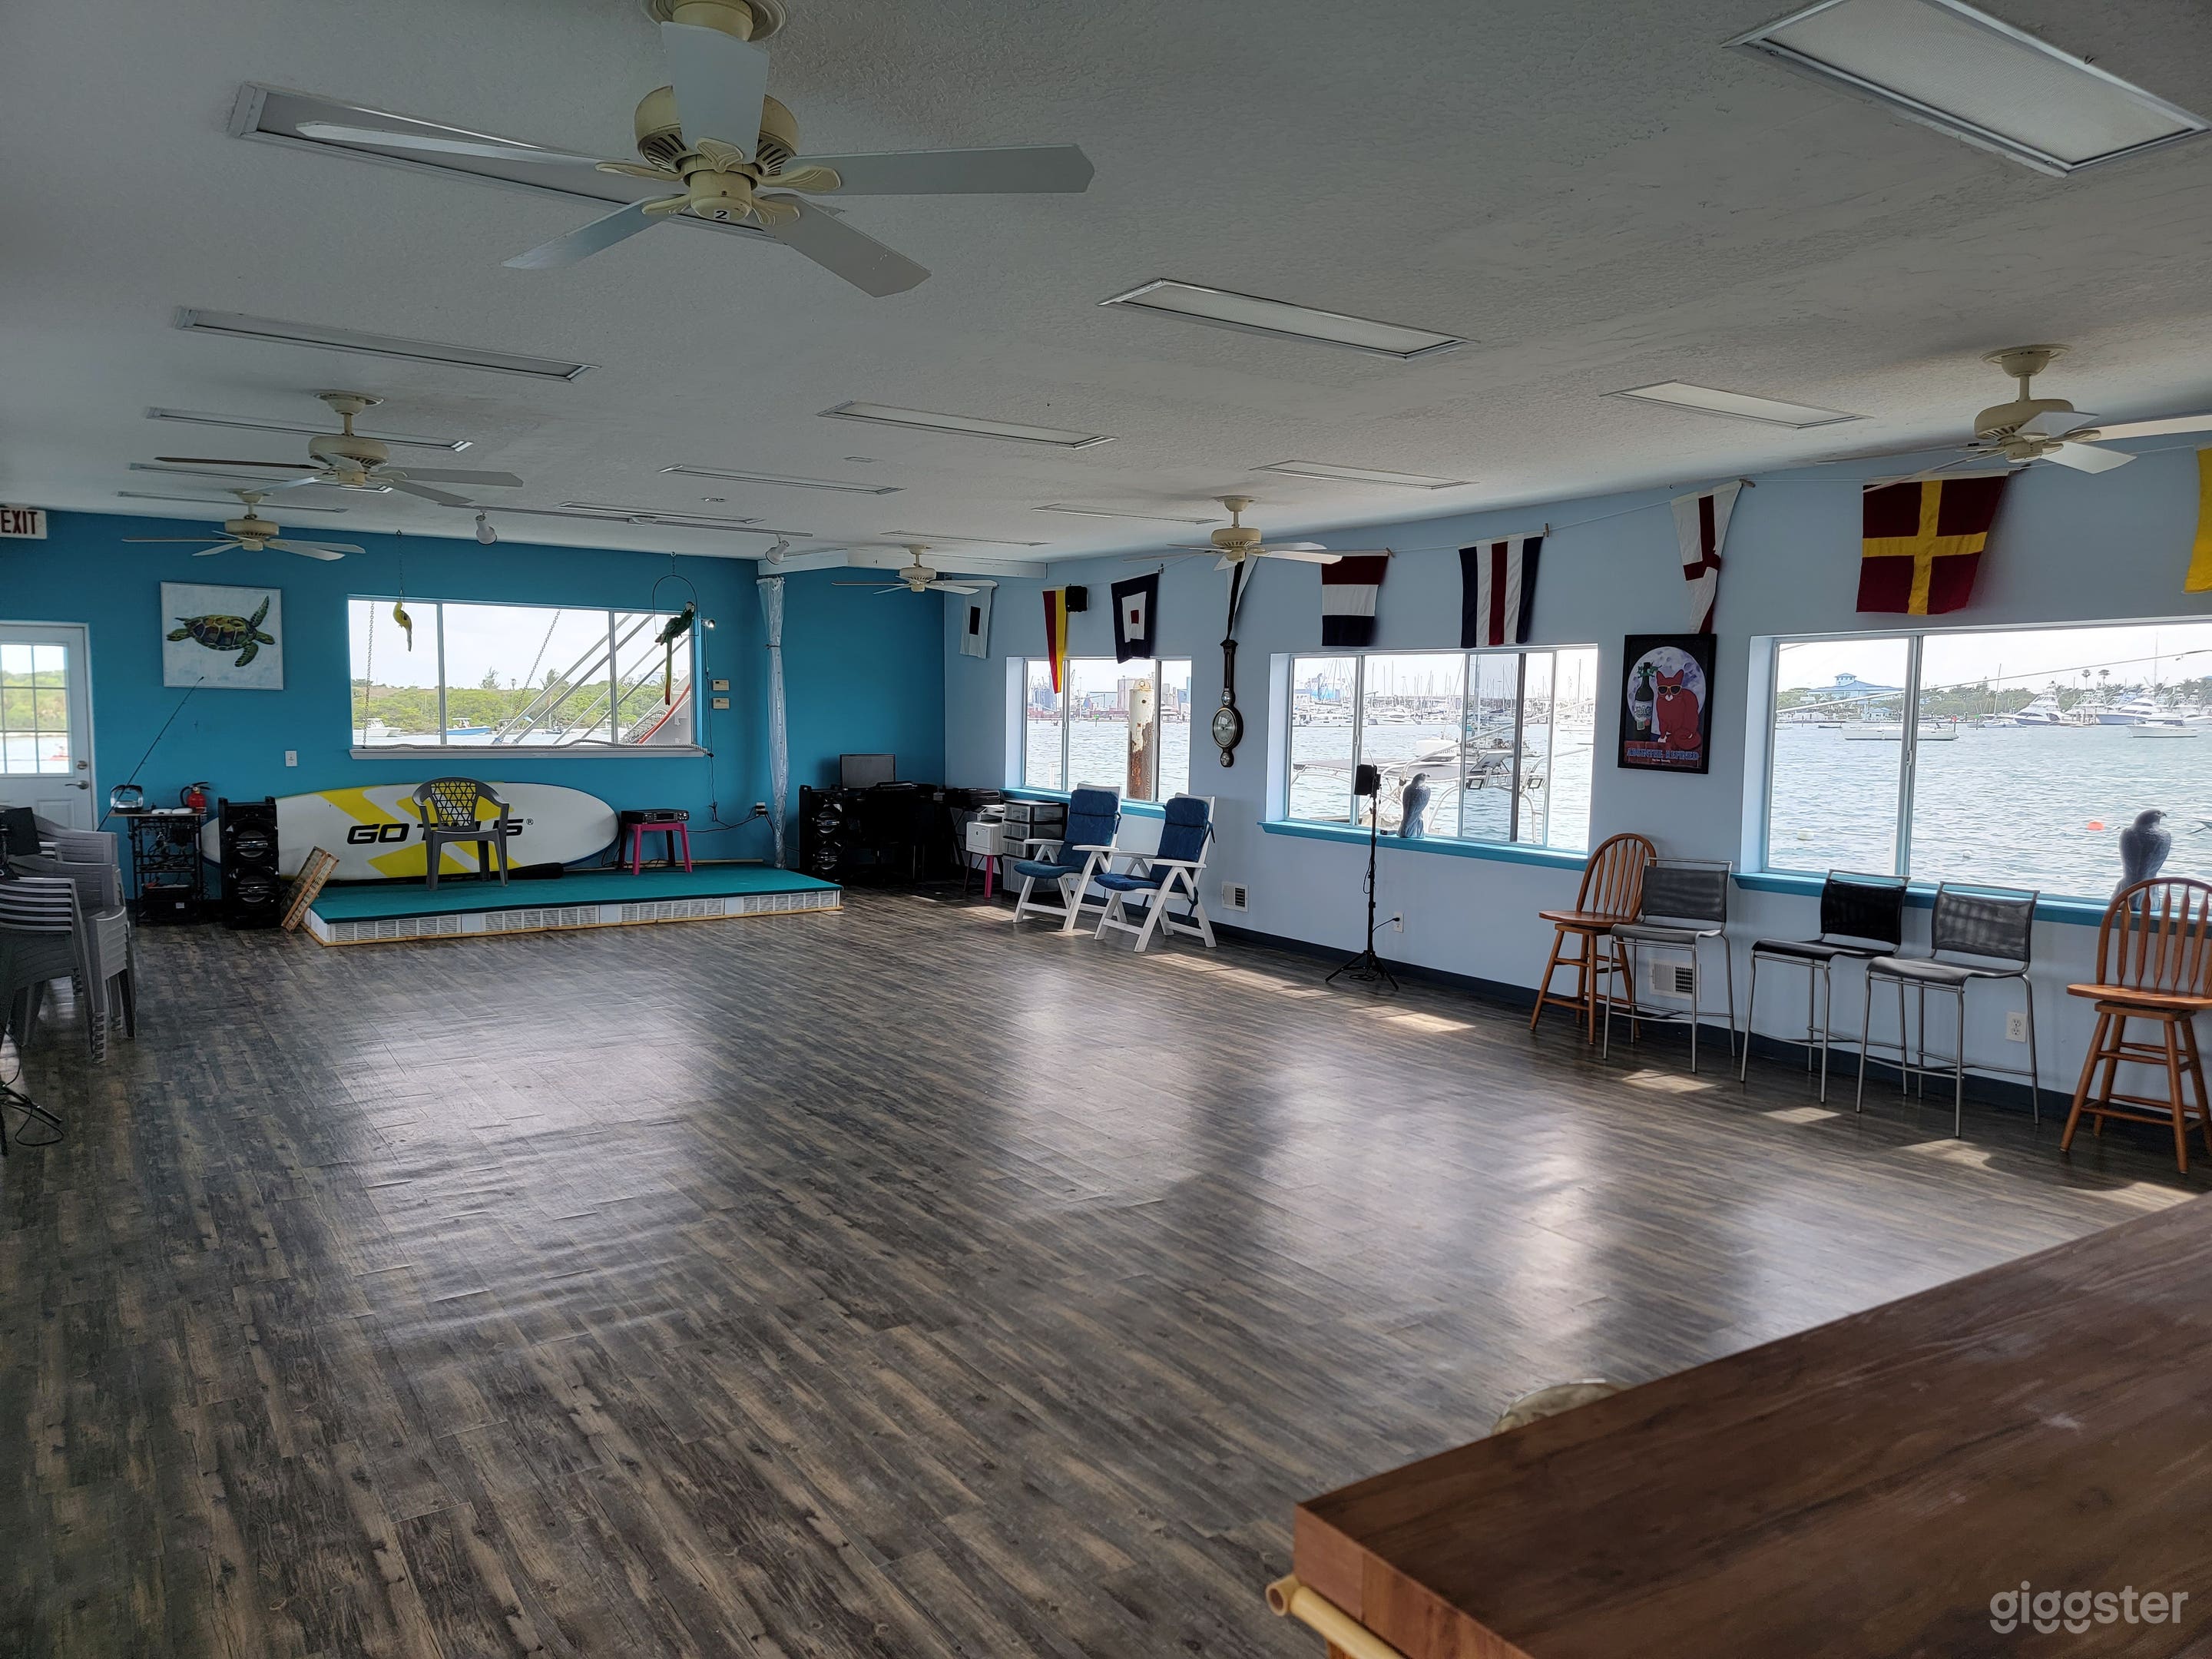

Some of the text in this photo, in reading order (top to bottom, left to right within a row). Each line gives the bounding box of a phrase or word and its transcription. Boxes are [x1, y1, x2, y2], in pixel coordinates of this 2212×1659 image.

[715, 210, 727, 220] 2
[1, 510, 38, 535] EXIT
[347, 823, 410, 844] GO
